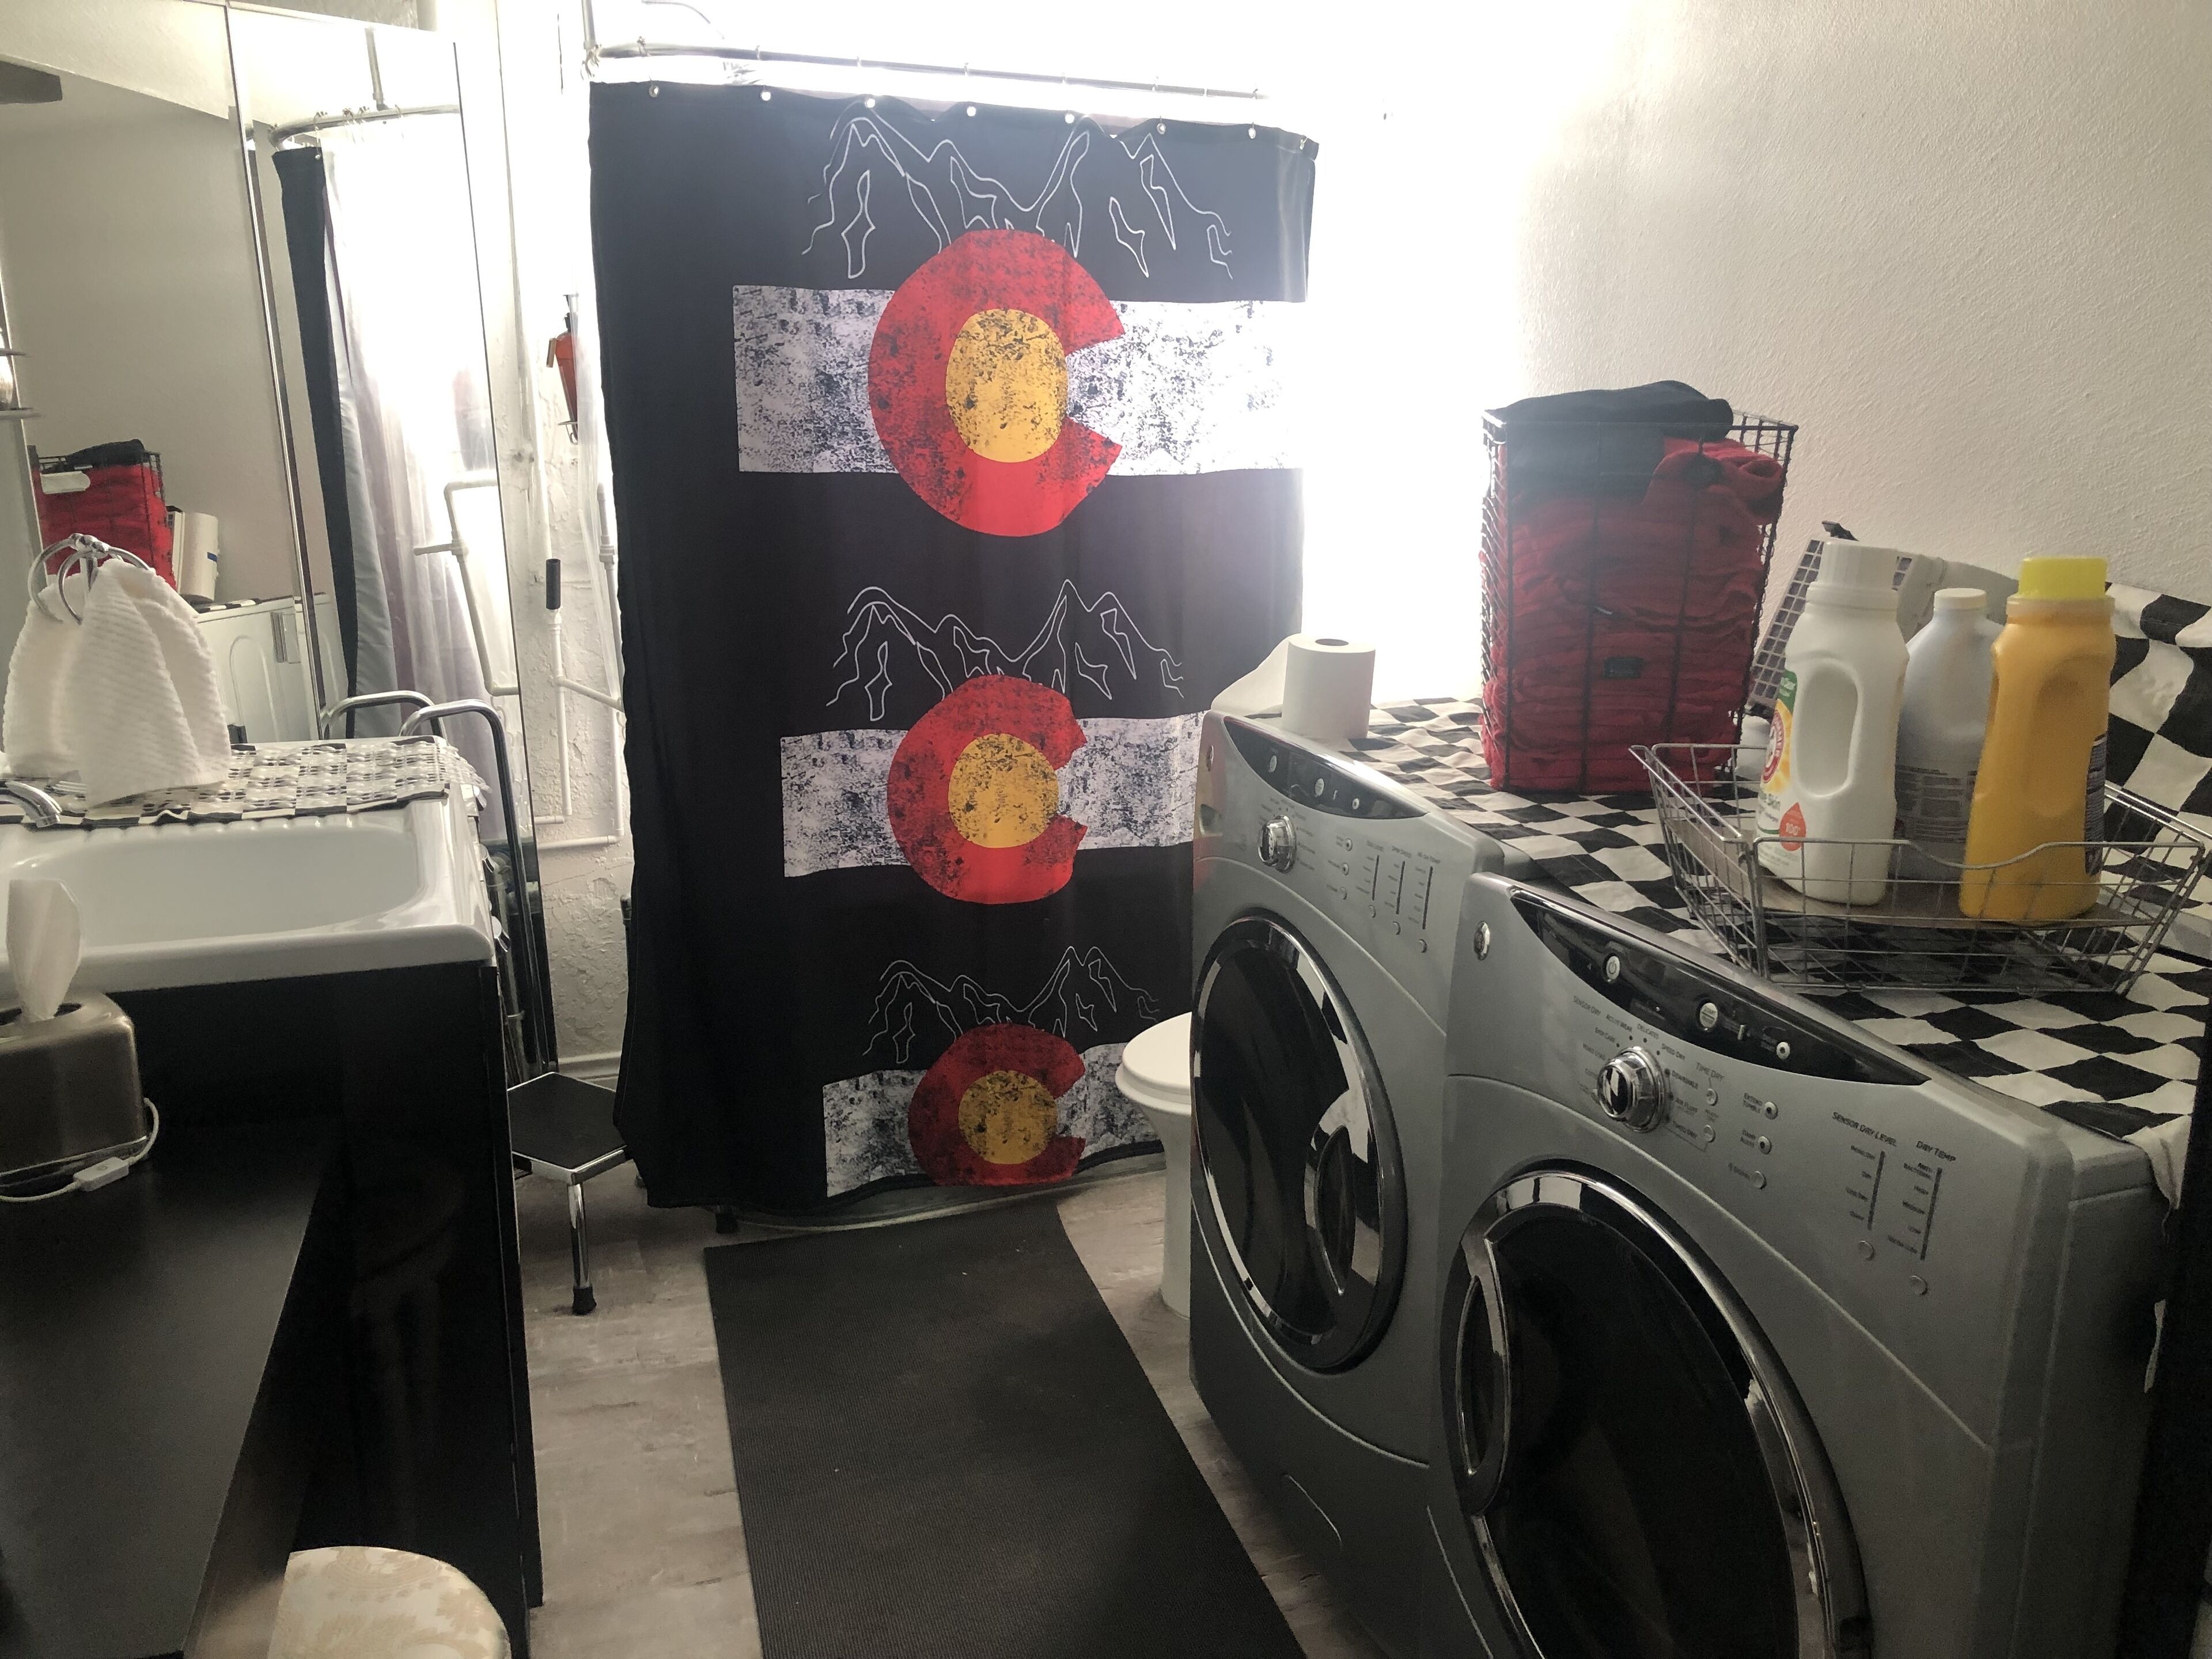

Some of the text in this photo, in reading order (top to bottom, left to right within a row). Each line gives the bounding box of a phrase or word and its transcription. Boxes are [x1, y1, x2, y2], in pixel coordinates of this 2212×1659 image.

[1637, 1022, 1660, 1039] DELICATES
[1661, 1043, 1686, 1061] SPEED DRY
[1696, 1061, 1725, 1082] TIME DRY
[1832, 1111, 1897, 1147] SENSOR DRY LEVEL
[1915, 1140, 1957, 1162] DRY TEMP
